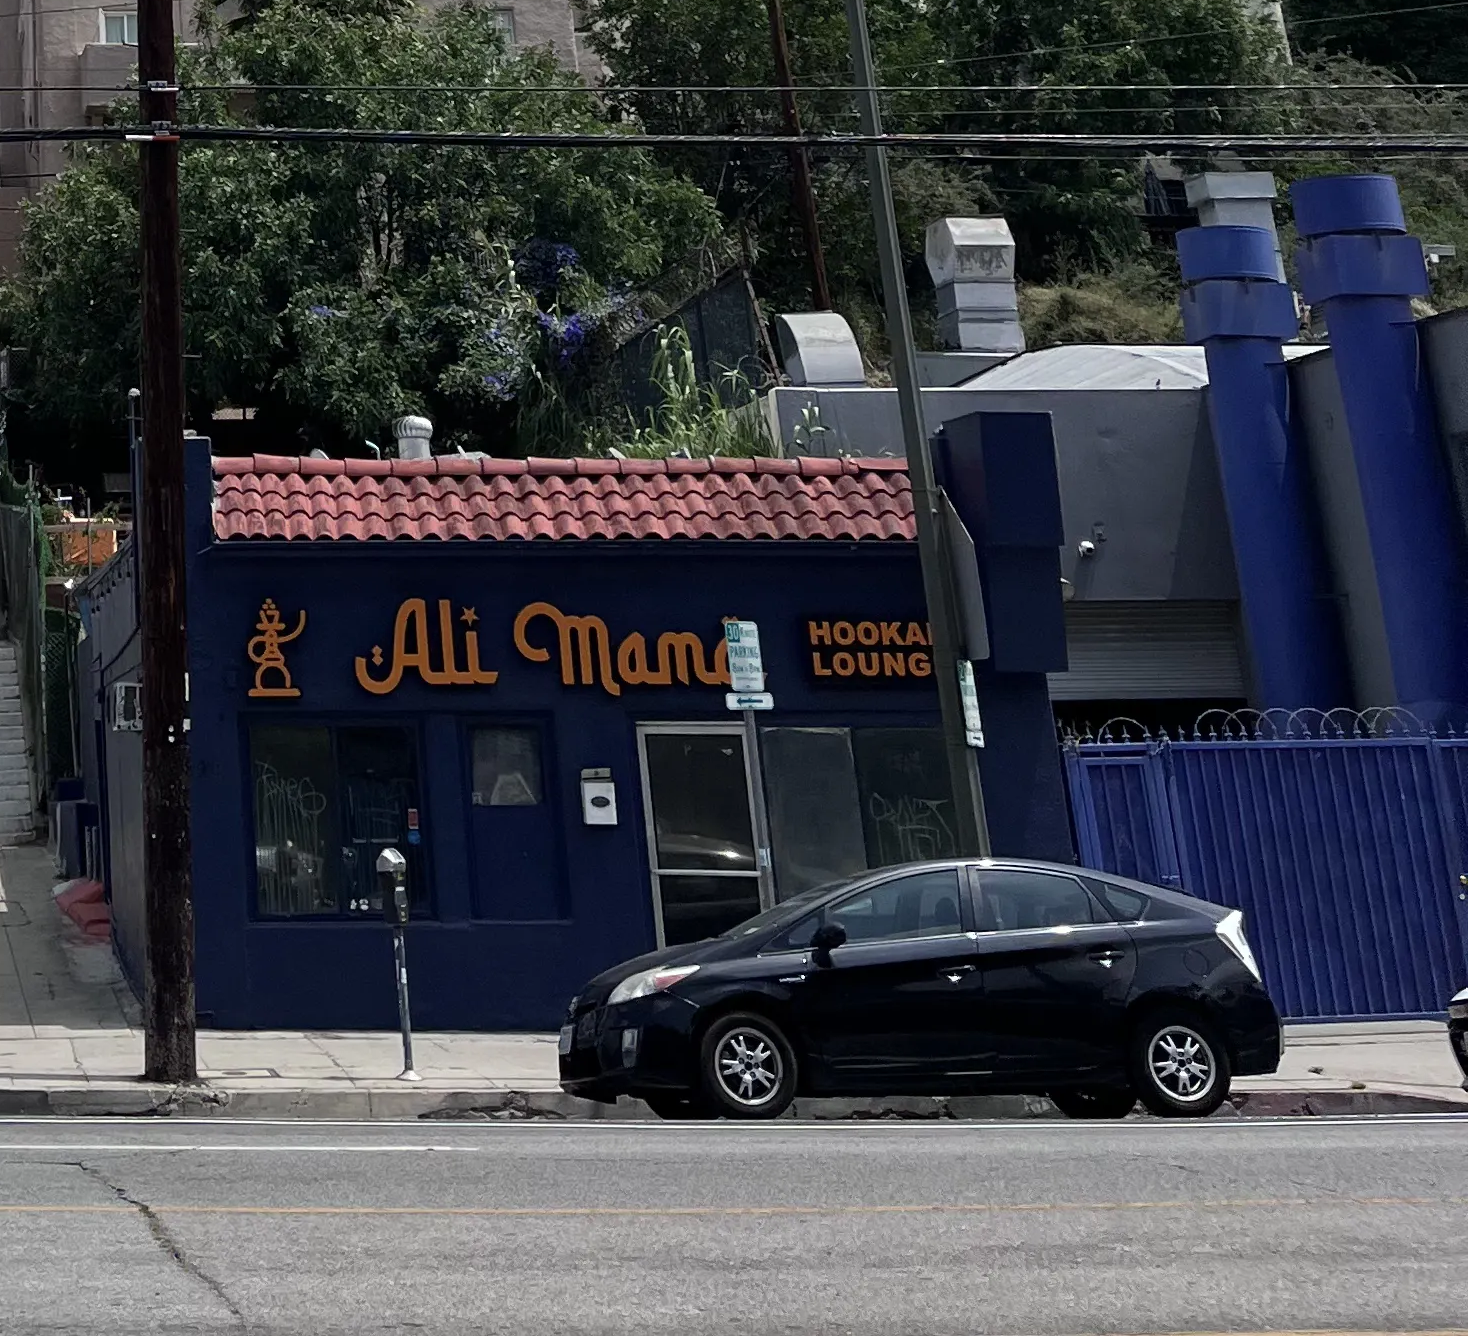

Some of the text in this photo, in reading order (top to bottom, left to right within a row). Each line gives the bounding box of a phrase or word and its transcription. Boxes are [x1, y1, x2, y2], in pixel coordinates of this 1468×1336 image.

[727, 624, 739, 641] 30
[355, 598, 499, 694] Ali
[730, 646, 759, 659] PARKING
[812, 652, 932, 676] LOUNG
